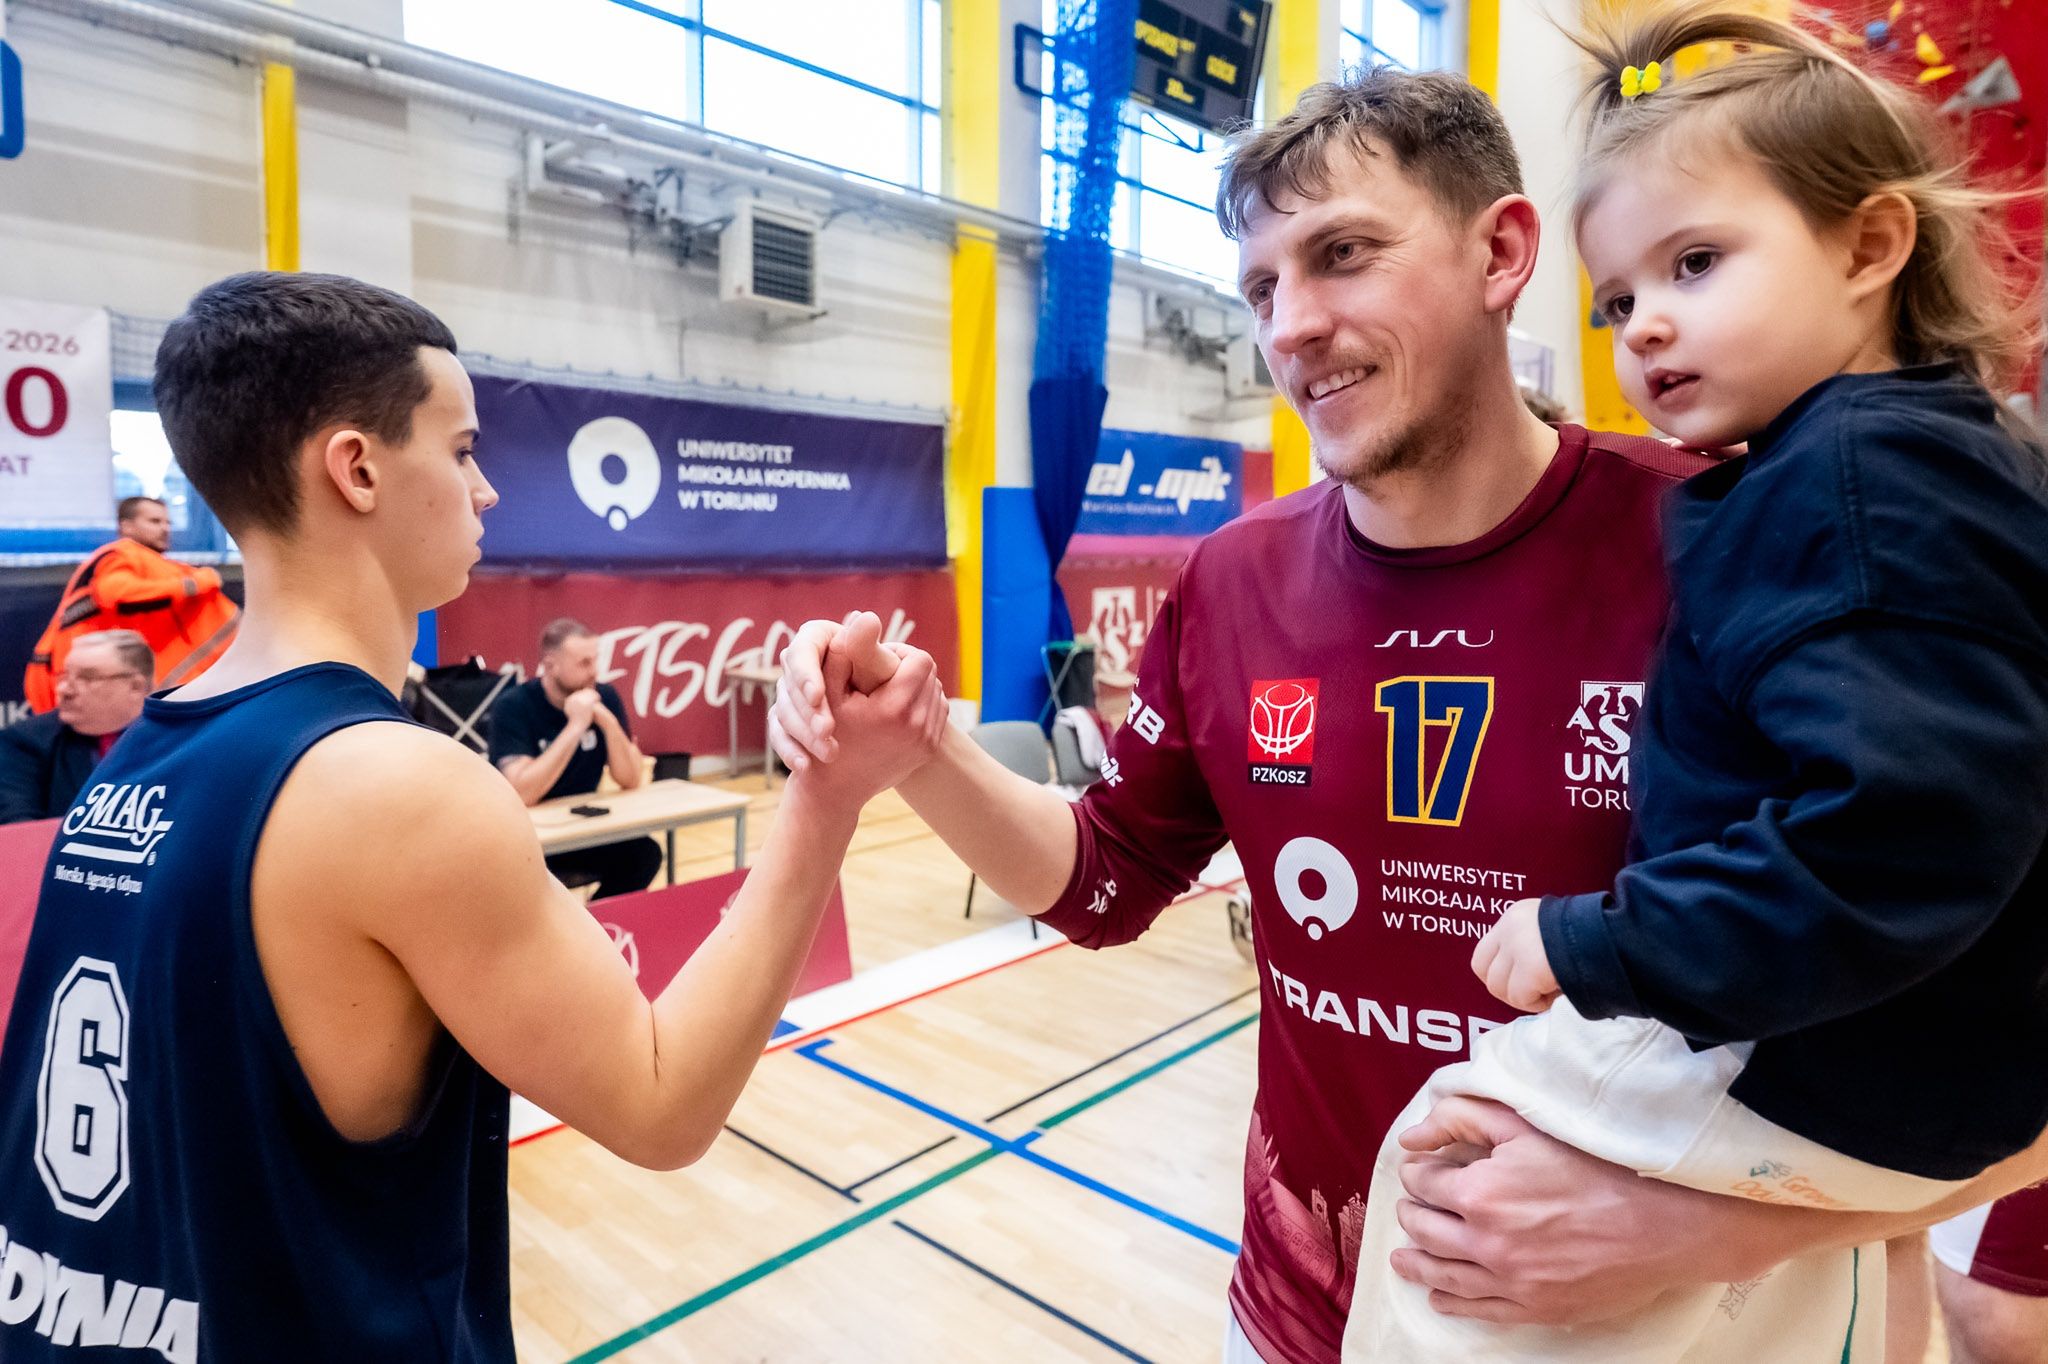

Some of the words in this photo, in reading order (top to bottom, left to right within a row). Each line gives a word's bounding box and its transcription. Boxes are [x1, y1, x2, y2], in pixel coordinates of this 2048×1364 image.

[677, 438, 794, 464] UNIWERSYTET
[764, 468, 851, 491] KOPERNIKA
[677, 490, 700, 510] W
[1374, 676, 1495, 827] 17
[62, 783, 175, 846] MAG
[1381, 859, 1526, 891] UNIWERSYTET
[1382, 885, 1486, 913] MIKOŁAJA
[1382, 911, 1404, 929] W
[34, 955, 130, 1221] 6
